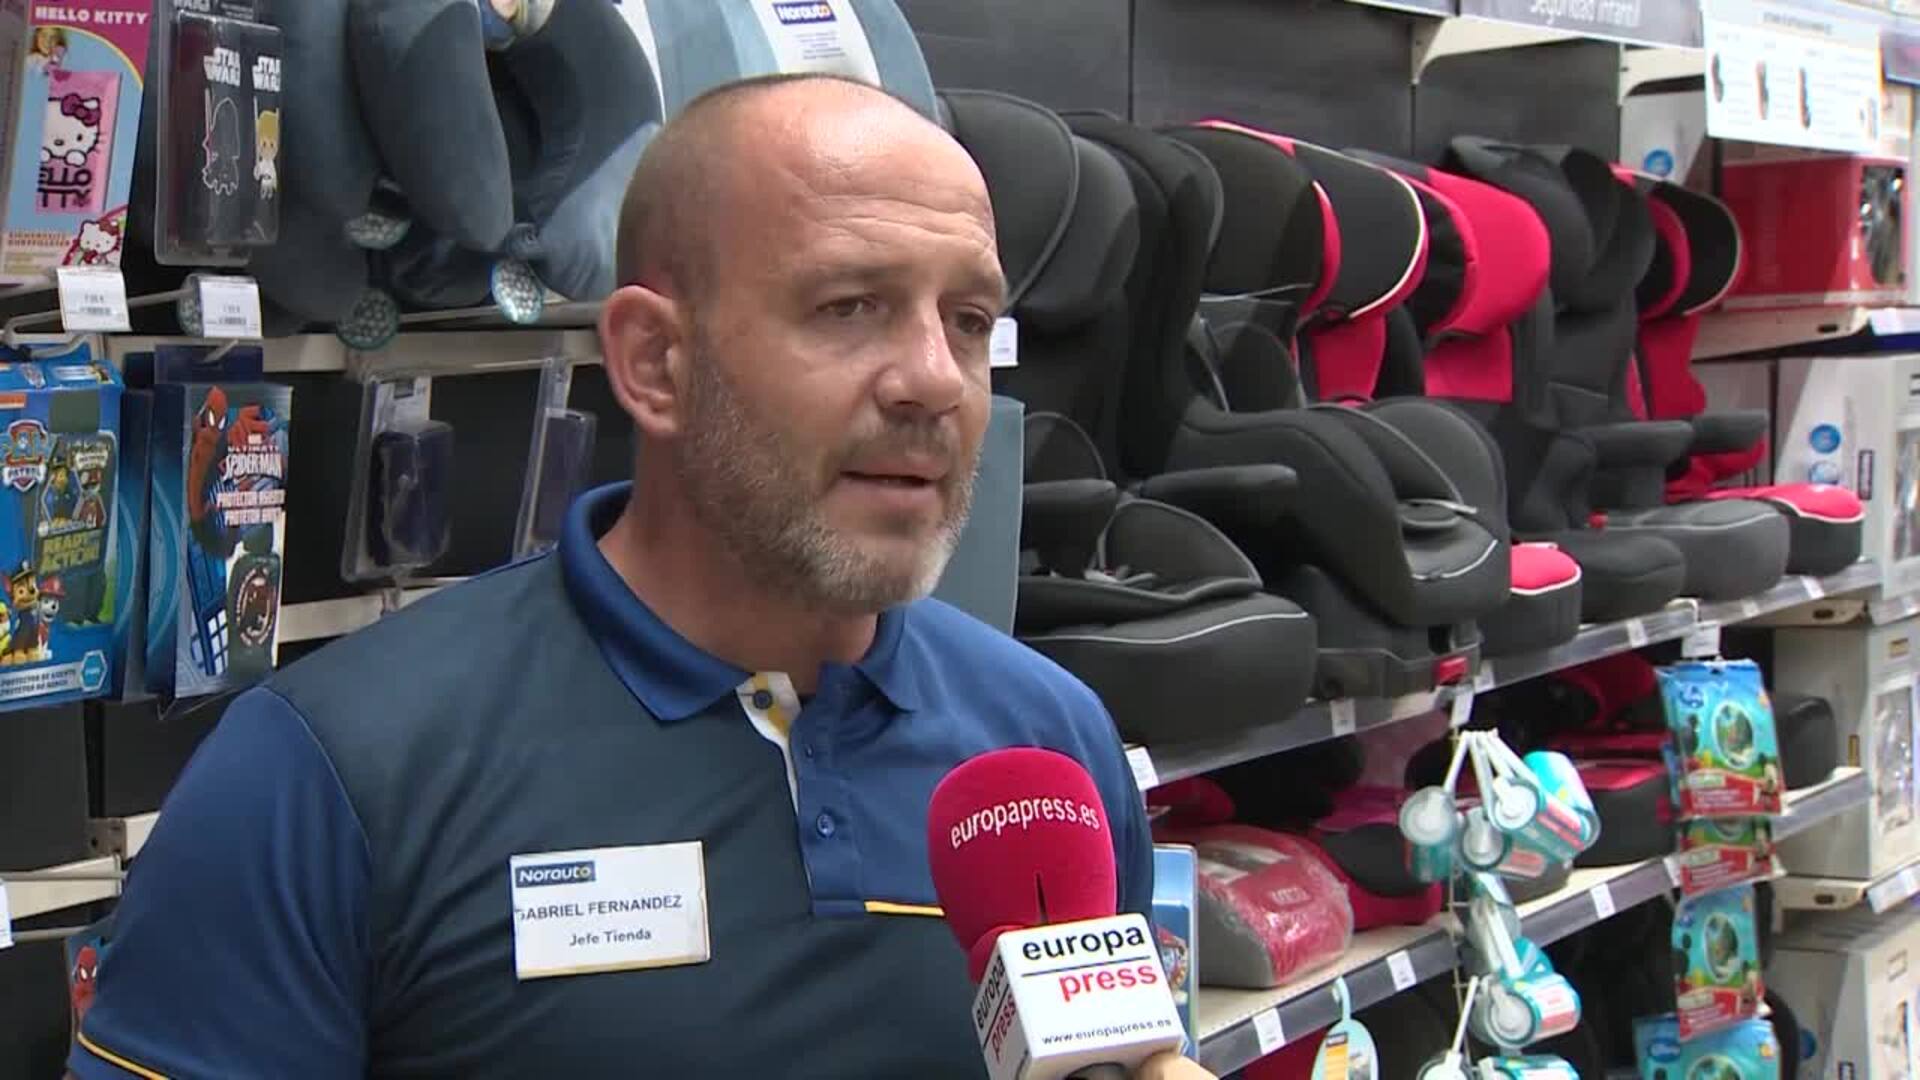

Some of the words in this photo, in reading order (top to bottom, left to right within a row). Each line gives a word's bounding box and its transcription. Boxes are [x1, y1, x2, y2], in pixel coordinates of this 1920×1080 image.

[35, 6, 90, 22] HELLO
[94, 9, 149, 24] KITTY
[777, 5, 830, 20] Norauto
[951, 798, 1100, 849] europapress.es
[519, 865, 592, 883] Norauto
[588, 895, 682, 915] FERNANDEZ
[569, 934, 600, 947] Jefe
[603, 928, 652, 943] Tienda
[1022, 925, 1146, 961] europa
[976, 953, 1006, 1030] europa
[1059, 964, 1158, 1003] press
[992, 991, 1017, 1065] press
[1042, 1017, 1172, 1045] www.europapress.es
